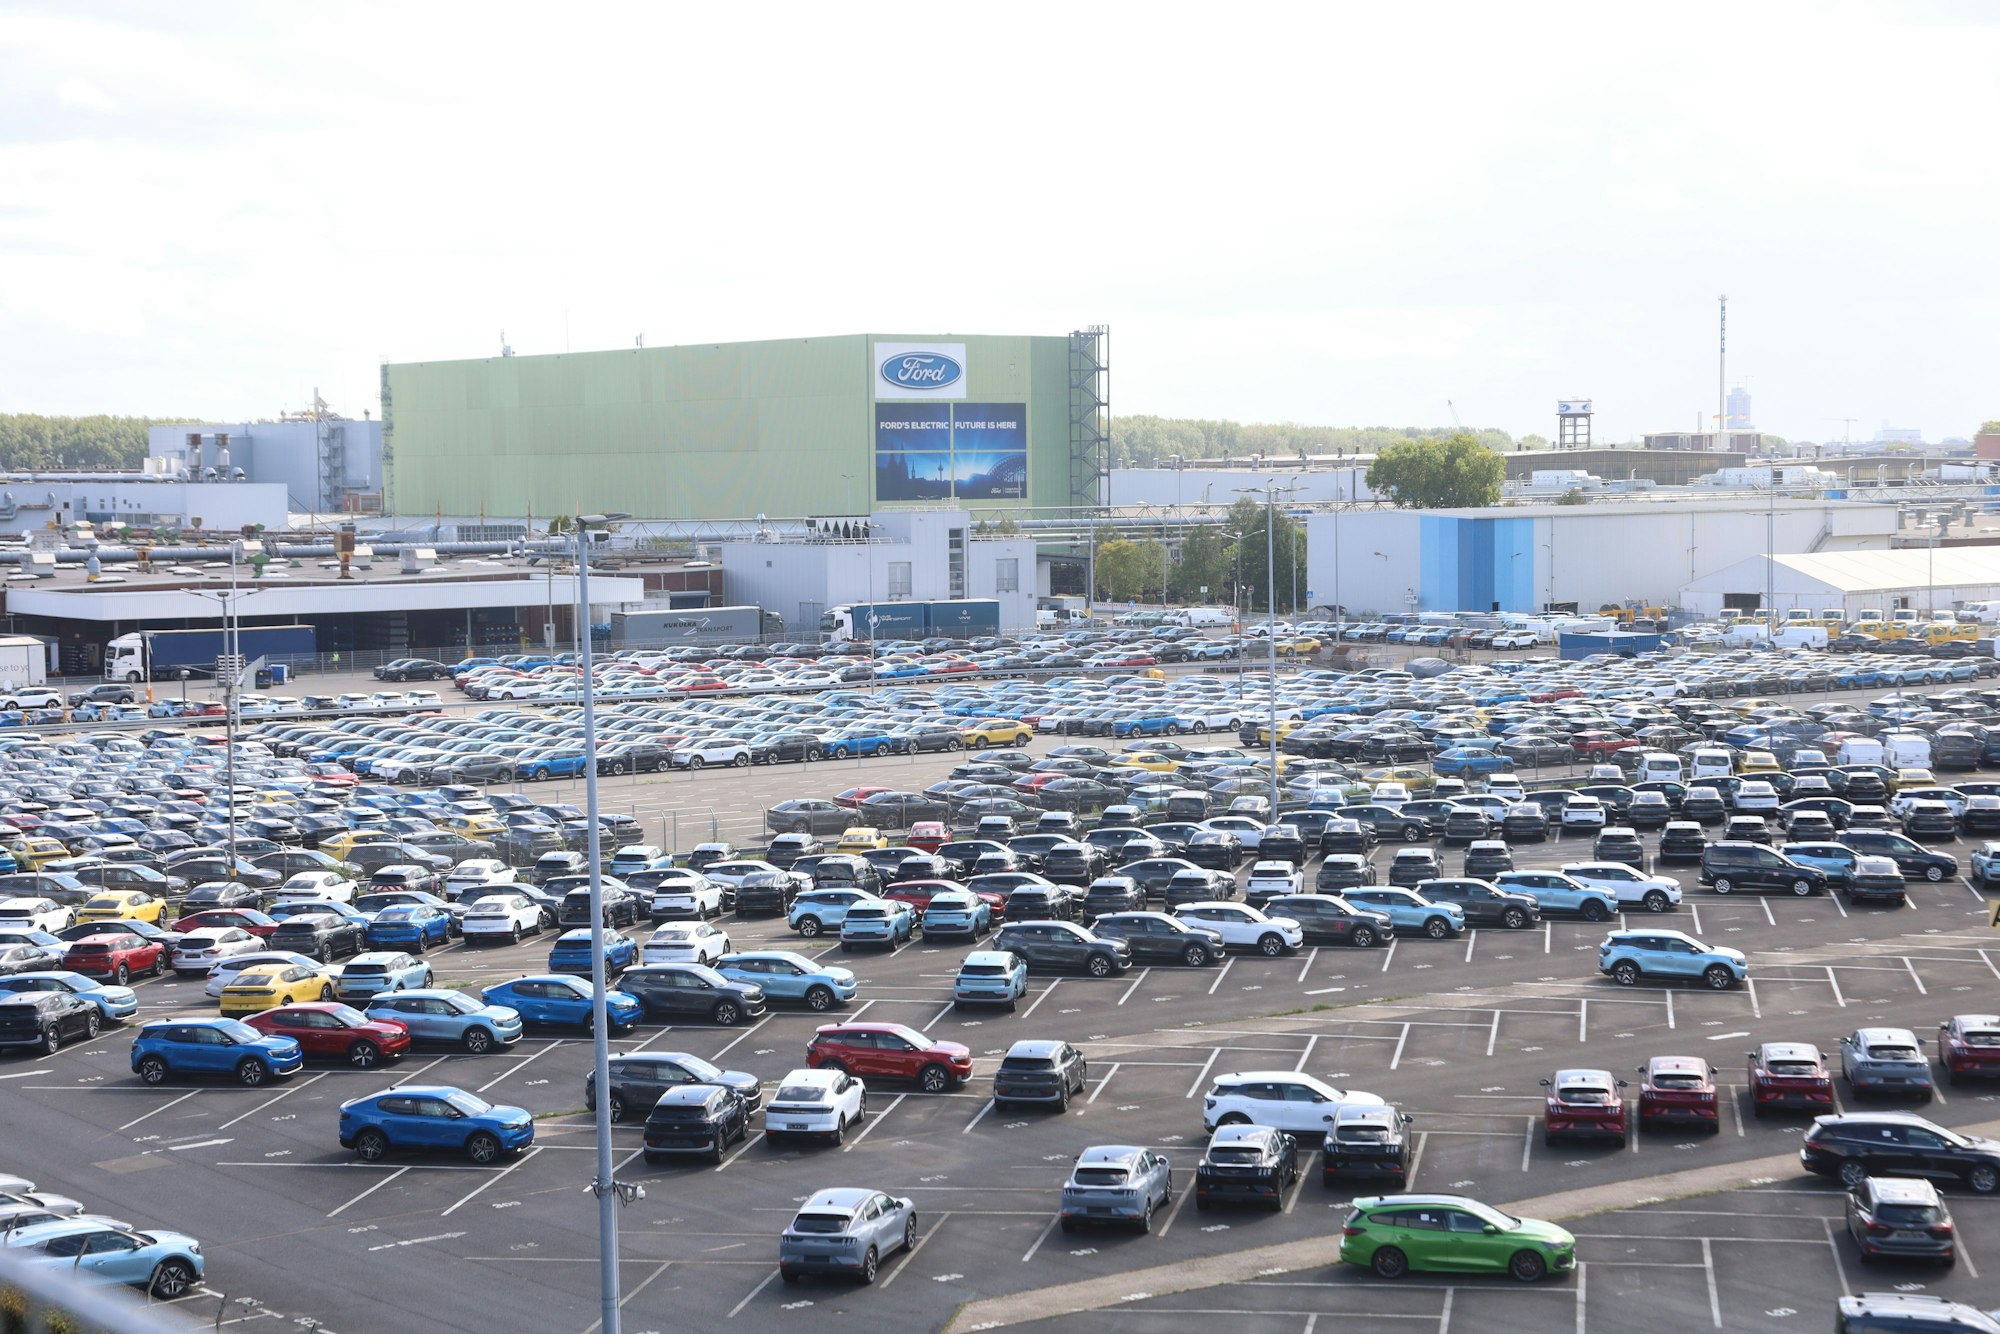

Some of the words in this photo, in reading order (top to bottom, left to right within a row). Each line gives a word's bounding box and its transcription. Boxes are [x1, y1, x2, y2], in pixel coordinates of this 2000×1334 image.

[897, 356, 946, 381] Ford
[880, 421, 910, 430] FORD'S
[911, 421, 949, 430] ELECTRIC
[954, 421, 986, 430] FUTURE
[987, 421, 996, 430] IS
[996, 421, 1017, 430] HERE
[696, 625, 733, 633] TRANSPORT
